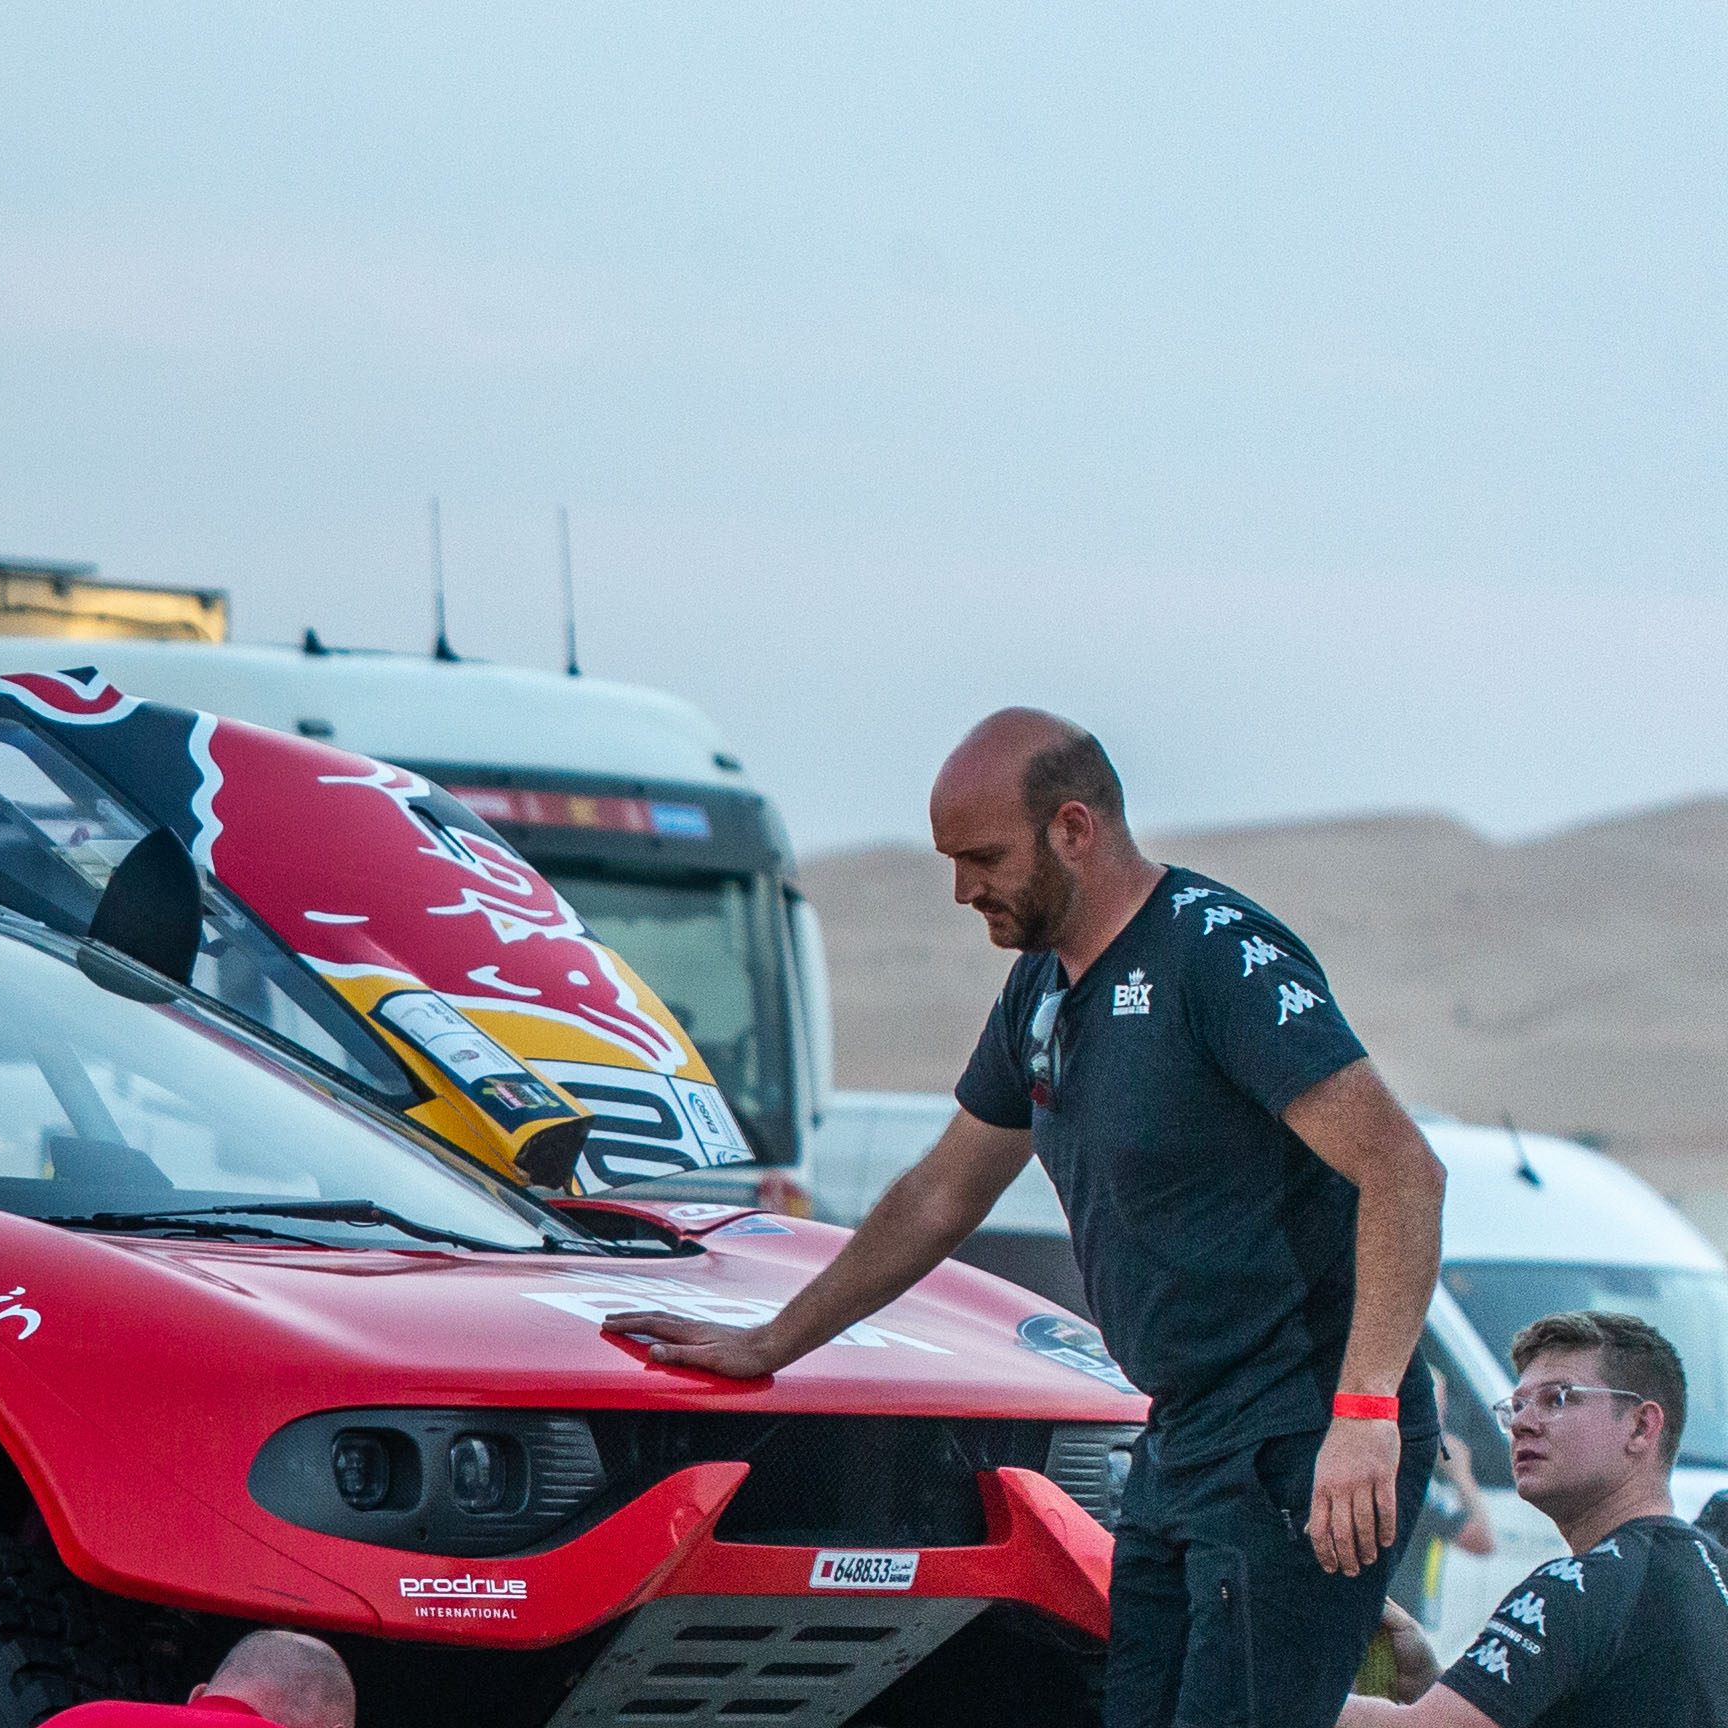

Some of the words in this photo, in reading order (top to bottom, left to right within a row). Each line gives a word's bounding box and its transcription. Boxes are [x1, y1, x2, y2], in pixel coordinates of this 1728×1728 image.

[1114, 984, 1153, 1006] BRX
[834, 1557, 892, 1583] 648833
[399, 1574, 528, 1597] prodrive
[414, 1607, 517, 1620] INTERNATIONAL
